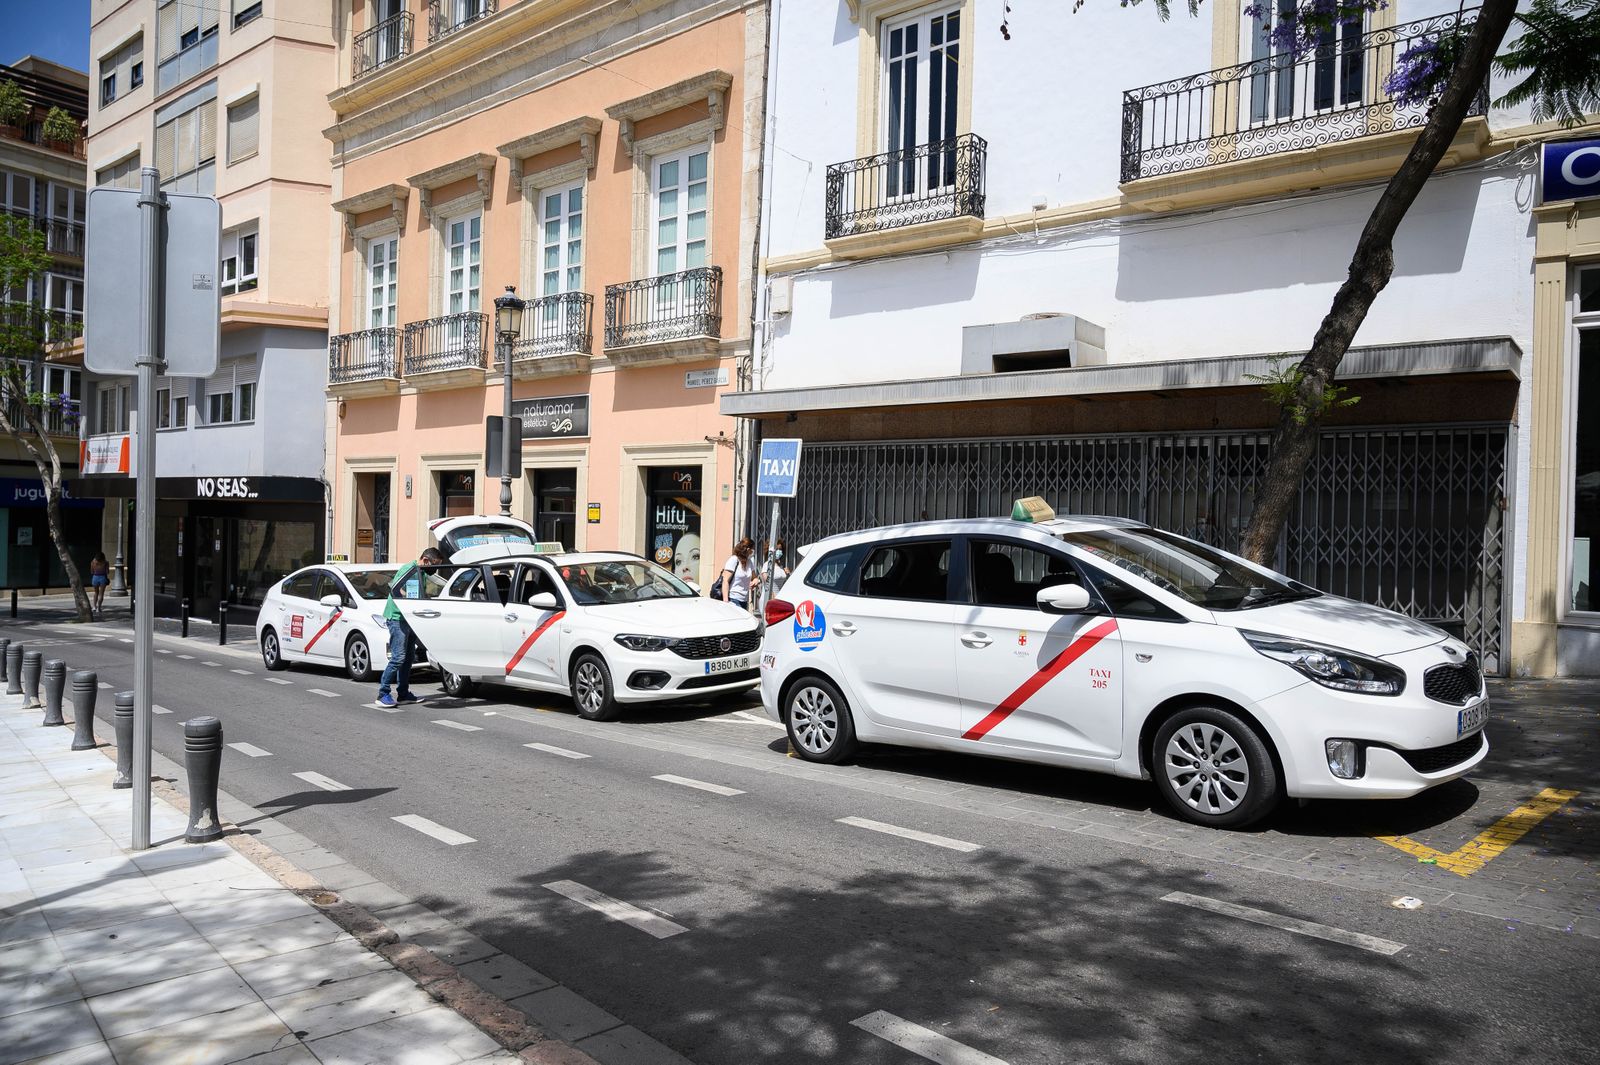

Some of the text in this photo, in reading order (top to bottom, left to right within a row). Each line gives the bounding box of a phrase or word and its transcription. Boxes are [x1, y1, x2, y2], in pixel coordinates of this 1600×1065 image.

[523, 403, 574, 417] naturamar
[523, 418, 548, 428] estética
[763, 459, 795, 476] TAXI
[197, 477, 258, 498] NO SEAS...
[656, 505, 686, 523] Hifu
[655, 523, 689, 531] ultratherapy
[711, 657, 748, 671] 8360 KJR
[1089, 668, 1111, 678] TAXI
[1092, 679, 1108, 689] 205
